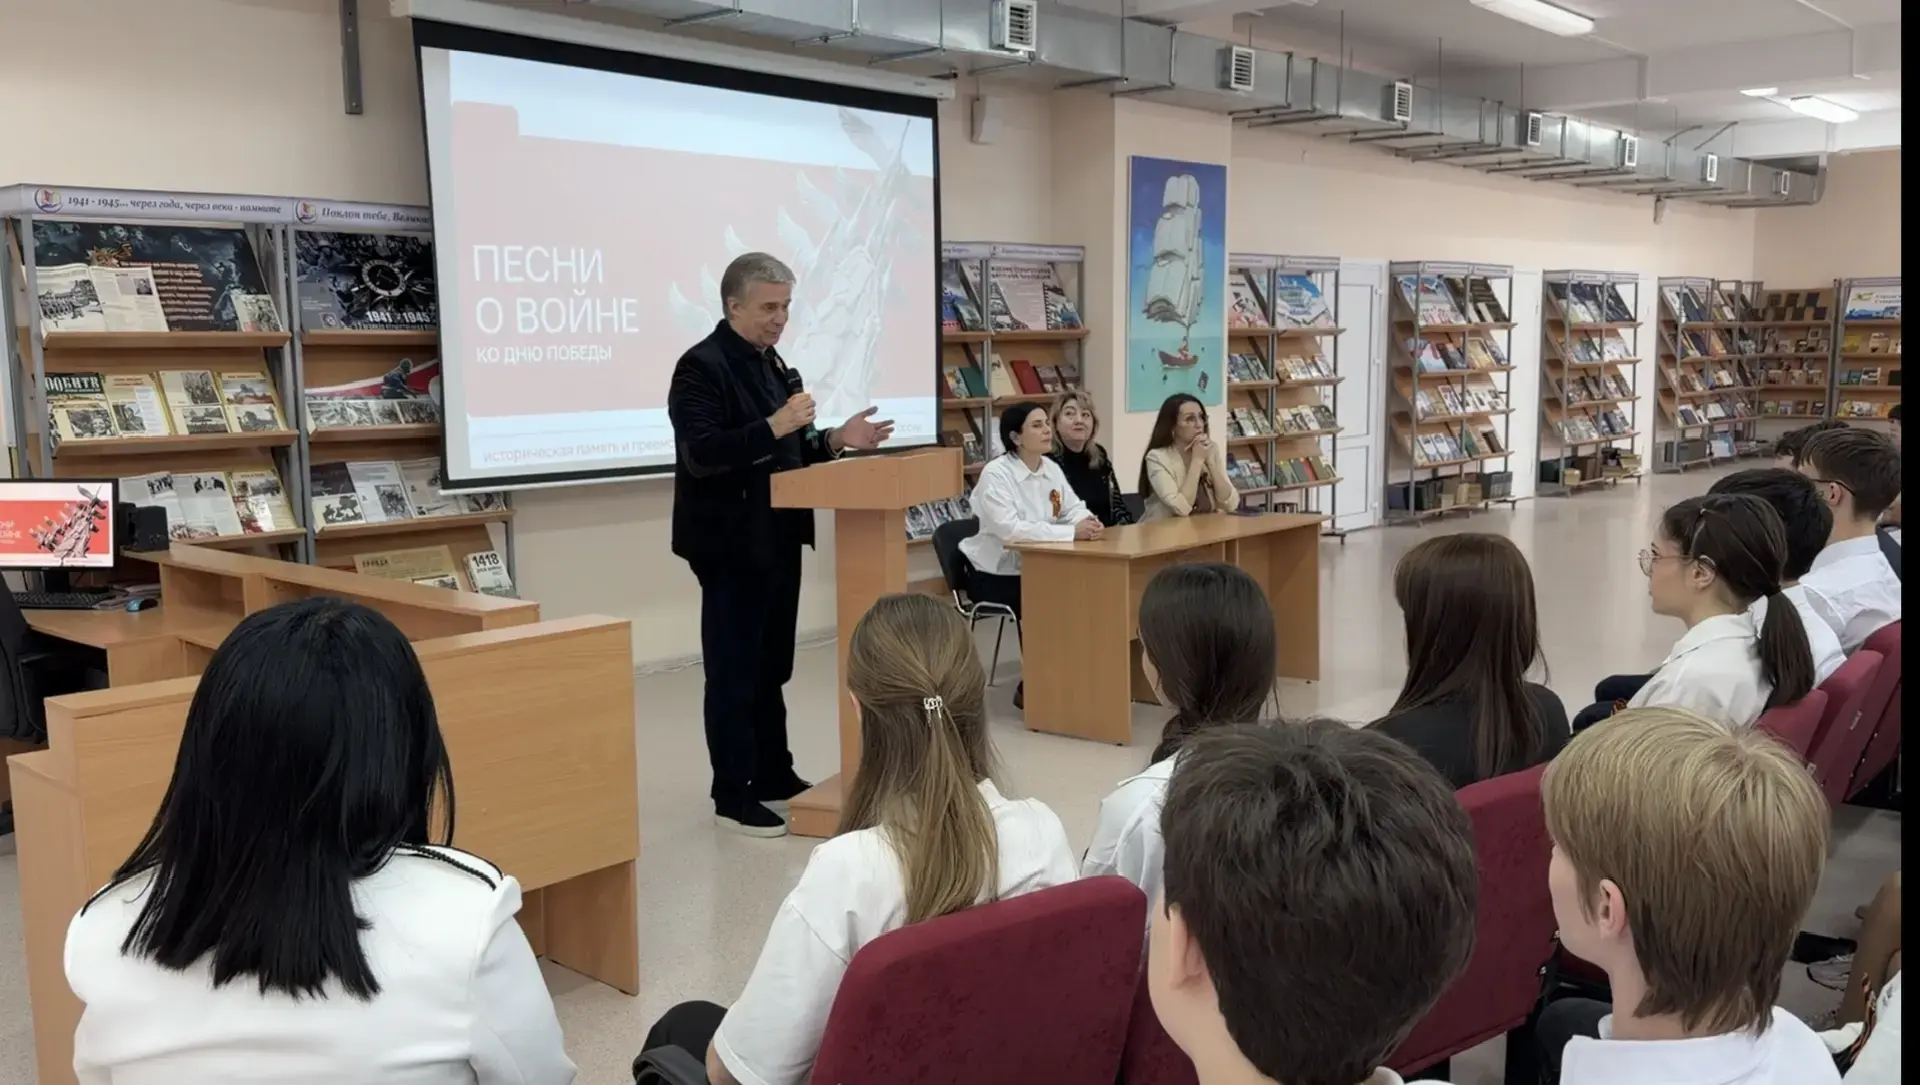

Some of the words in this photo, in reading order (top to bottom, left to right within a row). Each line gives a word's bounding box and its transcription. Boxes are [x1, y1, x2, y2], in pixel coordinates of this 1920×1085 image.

[68, 196, 89, 207] 1941
[130, 199, 157, 210] через
[158, 196, 183, 210] года,
[185, 201, 211, 212] через
[322, 207, 361, 219] Поклон
[362, 209, 390, 222] тебе,
[472, 244, 604, 284] ПЕСНИ
[366, 311, 393, 323] 1941
[402, 312, 431, 323] 1945
[476, 297, 503, 334] О
[515, 288, 640, 334] ВОЙНЕ
[476, 346, 500, 363] КО
[504, 346, 543, 364] ДНЮ
[547, 344, 612, 363] ПОБЕДЫ
[483, 445, 574, 463] историческая
[576, 442, 619, 455] память
[622, 441, 630, 453] и
[472, 553, 500, 567] 1418
